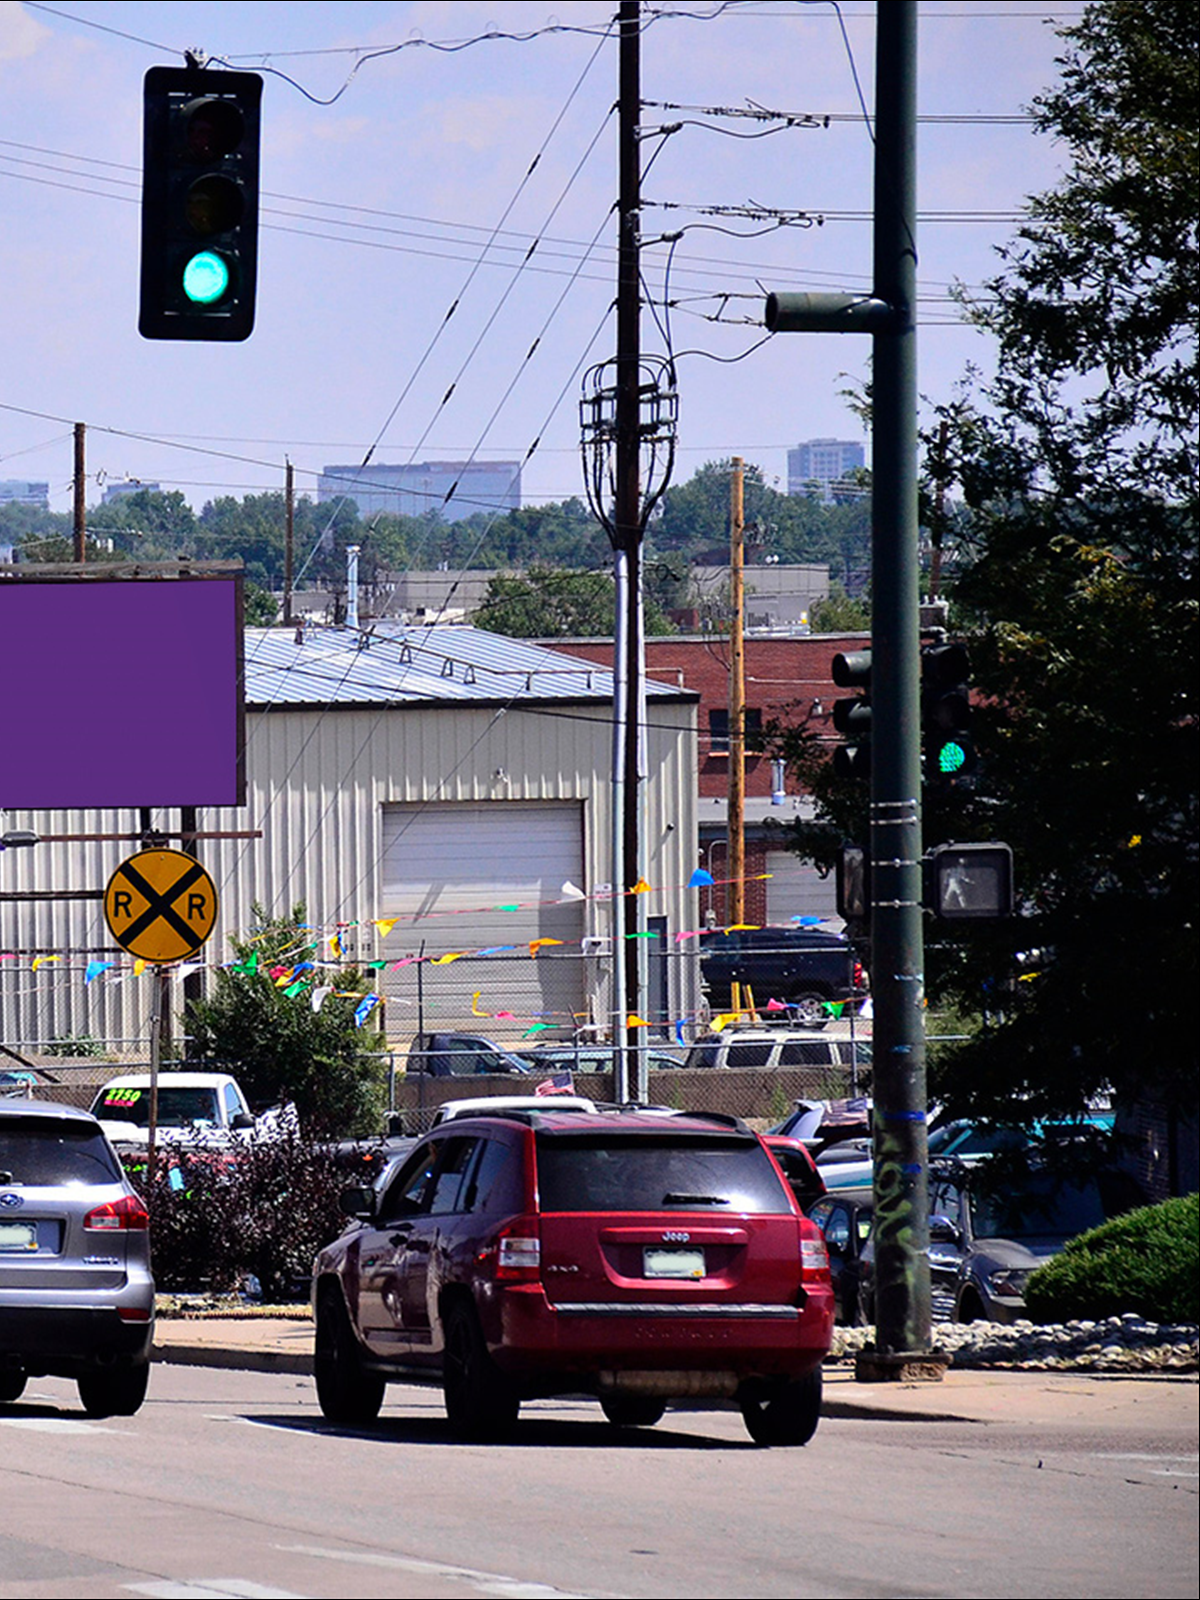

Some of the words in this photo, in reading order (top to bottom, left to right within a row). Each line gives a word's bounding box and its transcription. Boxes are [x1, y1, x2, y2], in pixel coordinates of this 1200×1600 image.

[113, 891, 132, 918] R
[187, 893, 206, 920] R
[105, 1088, 142, 1102] 2750
[661, 1231, 691, 1243] Jeep
